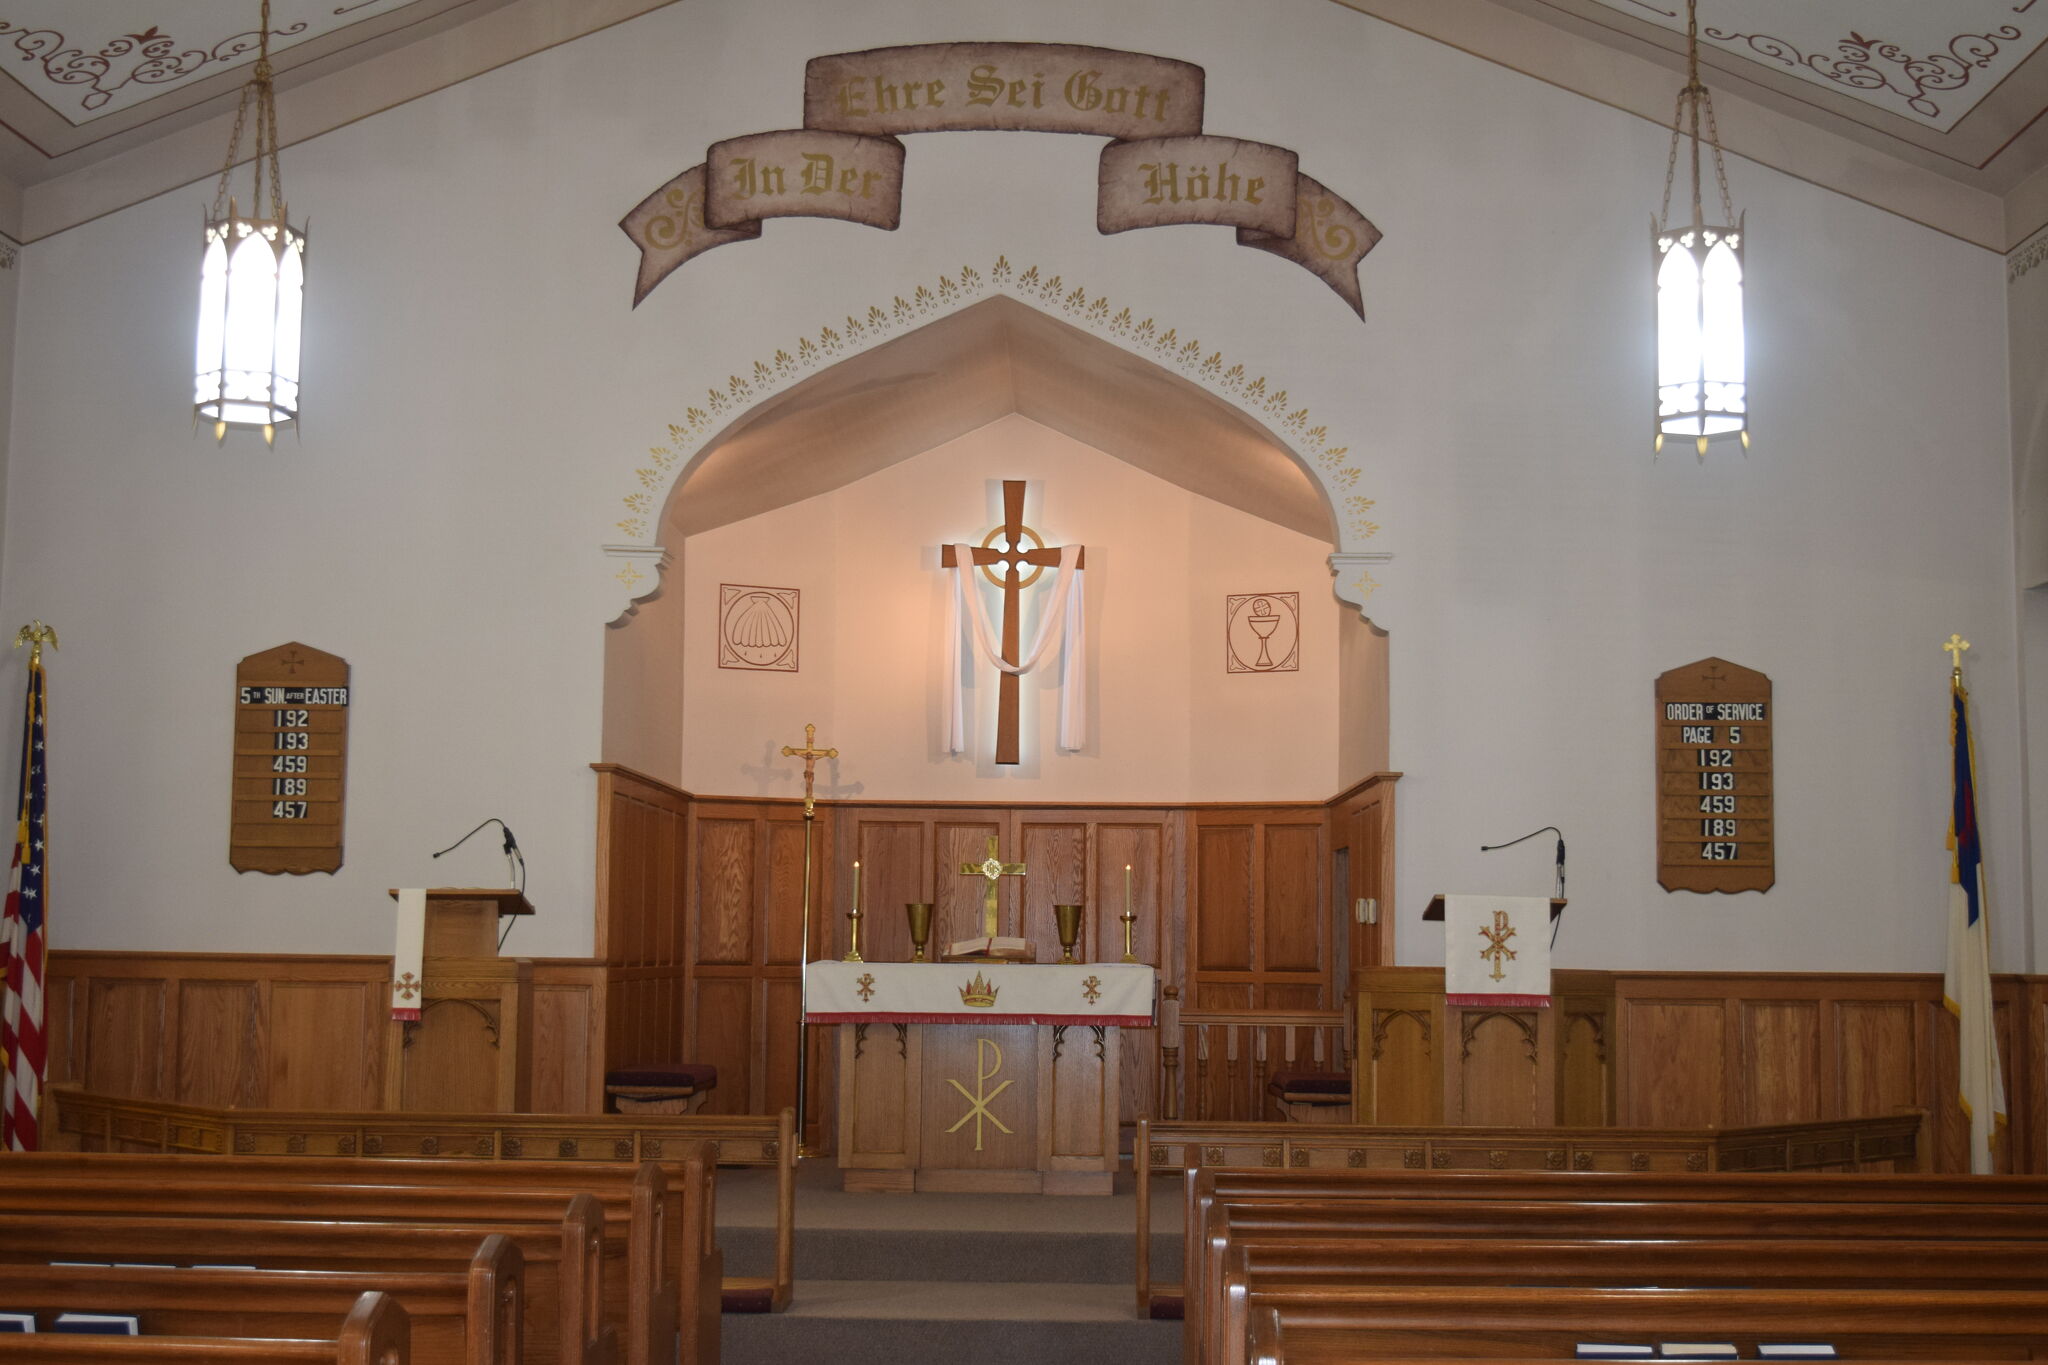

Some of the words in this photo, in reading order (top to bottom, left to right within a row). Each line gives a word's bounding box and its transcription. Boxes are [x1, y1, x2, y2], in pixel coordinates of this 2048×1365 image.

[836, 74, 946, 118] Ehre
[965, 64, 1045, 109] Sei
[1064, 69, 1171, 122] Gott
[729, 157, 786, 200] In
[800, 152, 882, 199] Der
[1137, 161, 1265, 205] Höhe
[265, 687, 287, 704] SUN.
[286, 692, 304, 700] AFTER
[305, 688, 347, 705] EASTER
[277, 709, 309, 727] 192
[1667, 703, 1704, 720] ORDER
[1705, 705, 1714, 714] OF
[1717, 703, 1763, 720] SERVICE
[277, 732, 309, 750] 193
[1683, 726, 1712, 743] PAGE
[1729, 726, 1741, 744] 5
[273, 755, 307, 773] 459
[1700, 749, 1732, 767] 192
[275, 778, 307, 795] 189
[1702, 773, 1734, 790] 193
[273, 801, 307, 819] 457
[1700, 795, 1735, 813] 459
[1703, 819, 1736, 836] 189
[1702, 843, 1737, 860] 457
